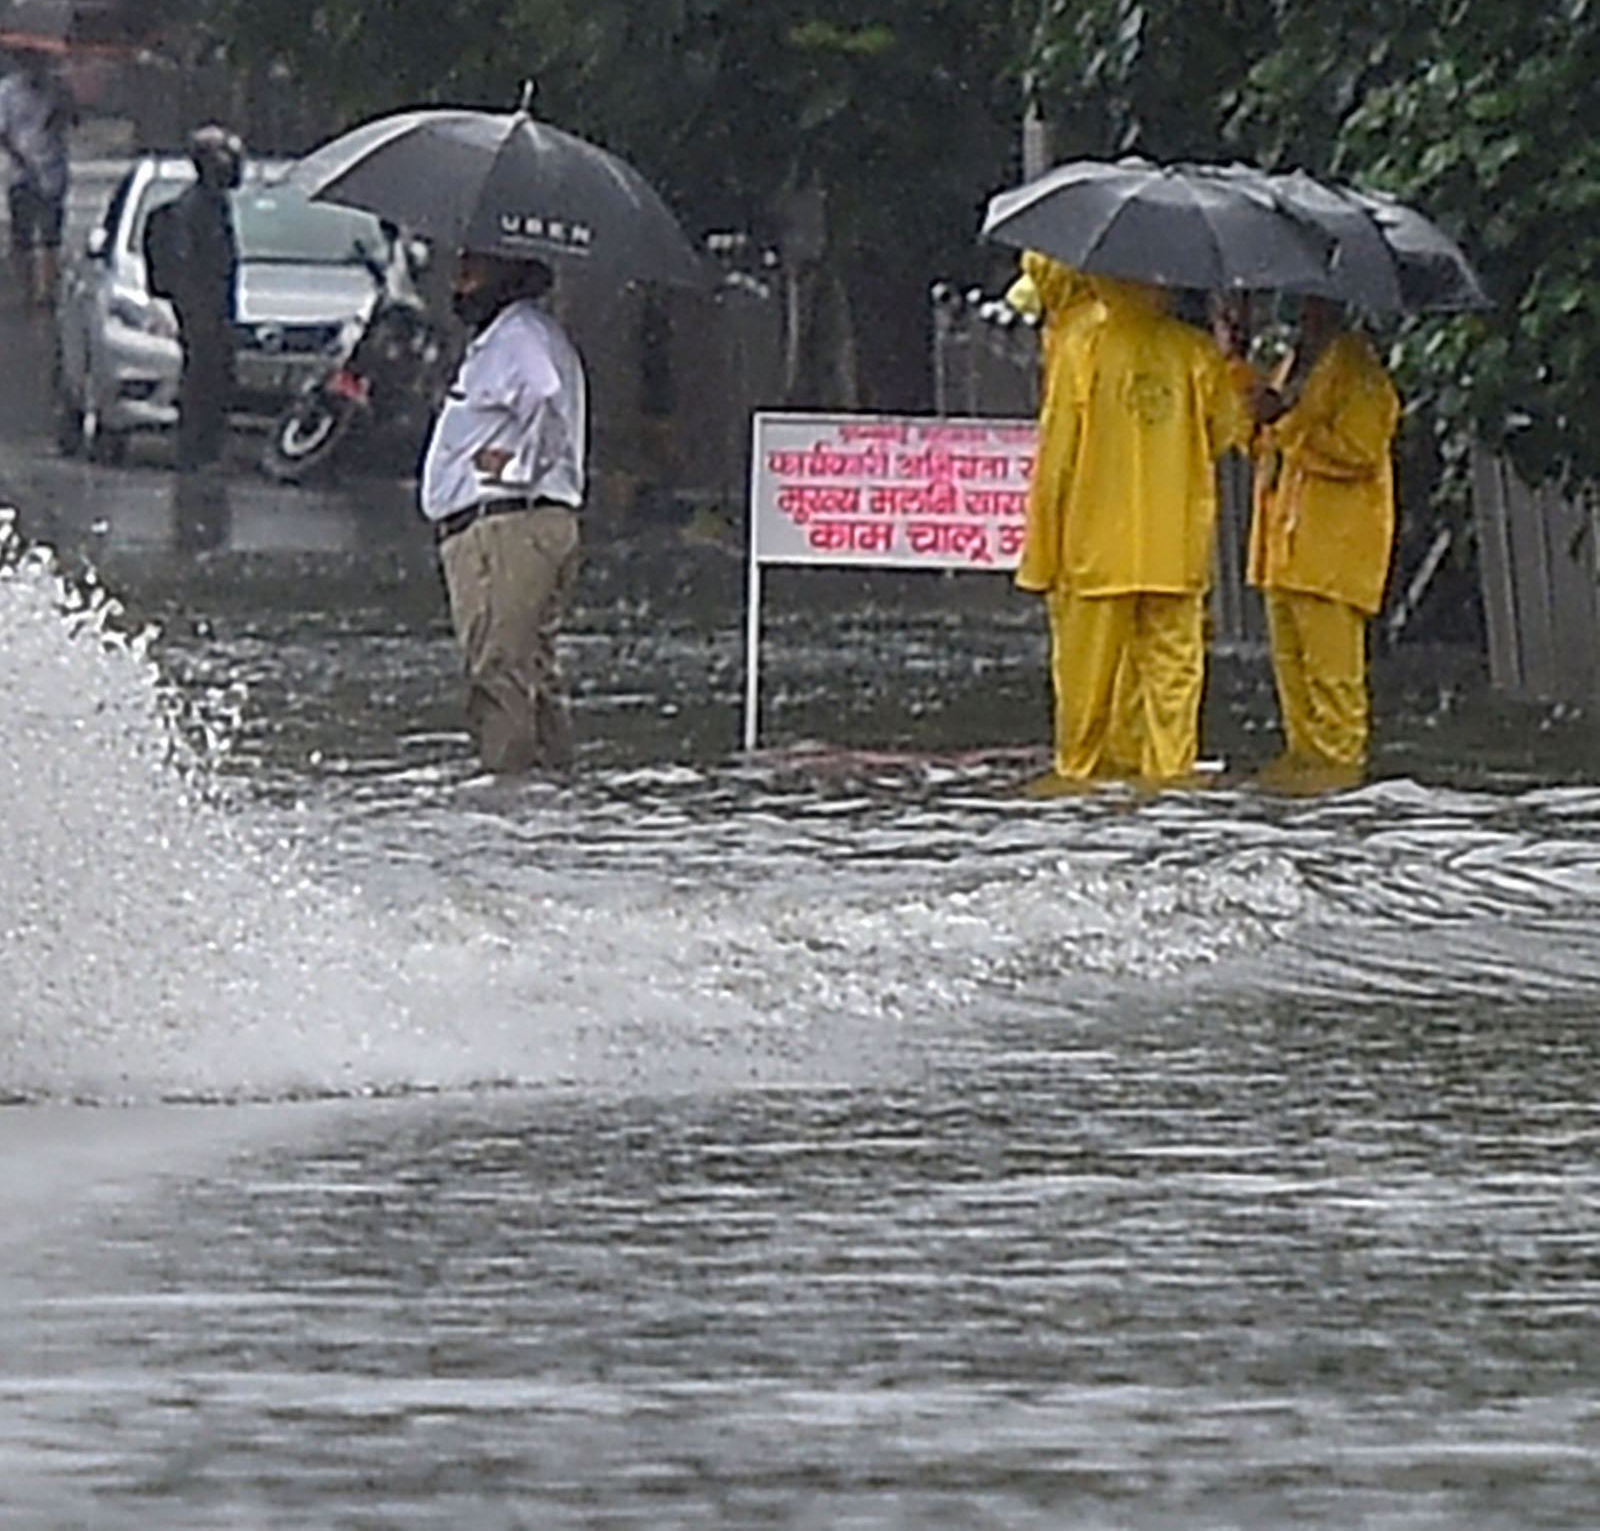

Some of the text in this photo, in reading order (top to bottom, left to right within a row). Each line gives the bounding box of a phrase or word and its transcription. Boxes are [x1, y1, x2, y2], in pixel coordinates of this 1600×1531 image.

[501, 215, 590, 244] UBER
[809, 520, 893, 551] काम
[907, 521, 991, 562] चालू
